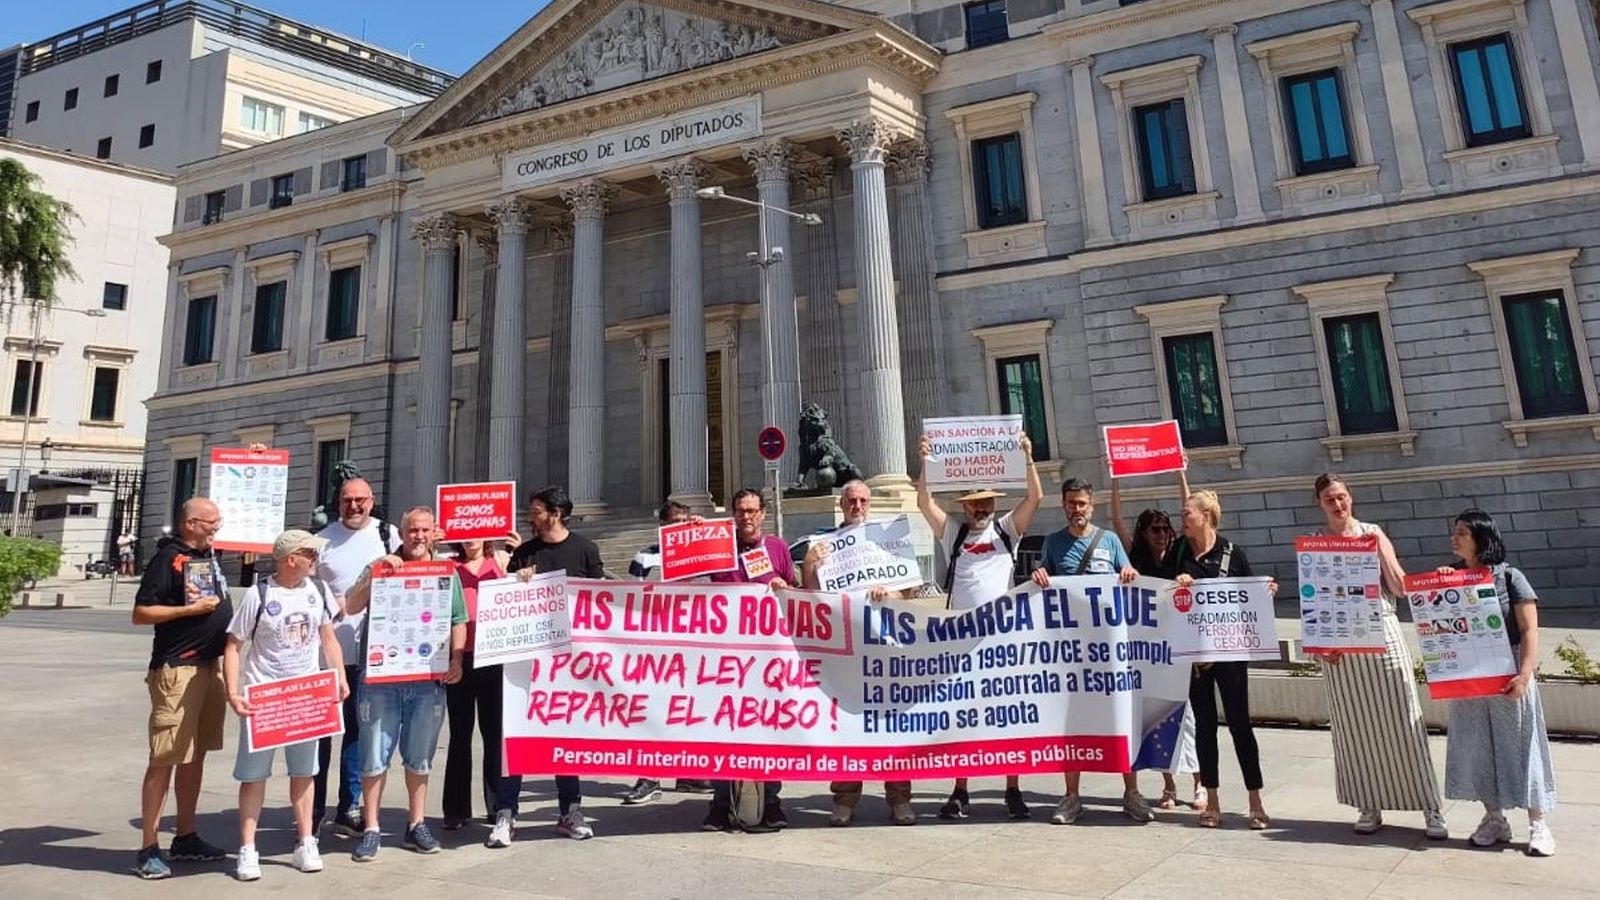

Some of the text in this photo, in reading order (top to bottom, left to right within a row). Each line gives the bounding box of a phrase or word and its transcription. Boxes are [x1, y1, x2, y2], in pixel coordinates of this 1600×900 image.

[517, 112, 743, 177] CONGRESO DE LOS DIPUTADOS
[927, 429, 944, 438] SIN
[948, 426, 995, 437] SANCIÓN
[998, 427, 1006, 435] A
[945, 457, 961, 467] NO
[455, 504, 495, 517] SOMOS
[446, 517, 507, 531] PERSONAS
[665, 526, 731, 547] FIJEZA
[826, 564, 908, 591] REPARADO
[494, 584, 564, 605] GOBIERNO
[1175, 590, 1249, 607] STOP CESES
[573, 584, 832, 640] AS LÍNEAS ROJAS
[863, 586, 1158, 646] LAS MARCA EL TJUE
[1198, 625, 1259, 637] PERSONAL
[1215, 637, 1261, 649] CESADO
[550, 653, 615, 686] POR
[622, 653, 684, 688] UNA
[697, 655, 756, 687] LEY
[763, 658, 822, 688] QUE
[863, 655, 884, 678] La
[890, 651, 972, 678] Directiva
[977, 639, 1083, 671] 1999/70/CE
[1087, 642, 1110, 662] se
[299, 681, 313, 690] LA
[314, 677, 332, 688] LEY
[863, 667, 1142, 704] La Comisión acorrala a España
[527, 690, 648, 727] REPARE
[666, 698, 707, 725] EL
[714, 695, 820, 732] ABUSO
[864, 701, 1039, 735] El tiempo se agota
[553, 744, 1104, 774] Personal interino y temporal de las administraciones públicas
